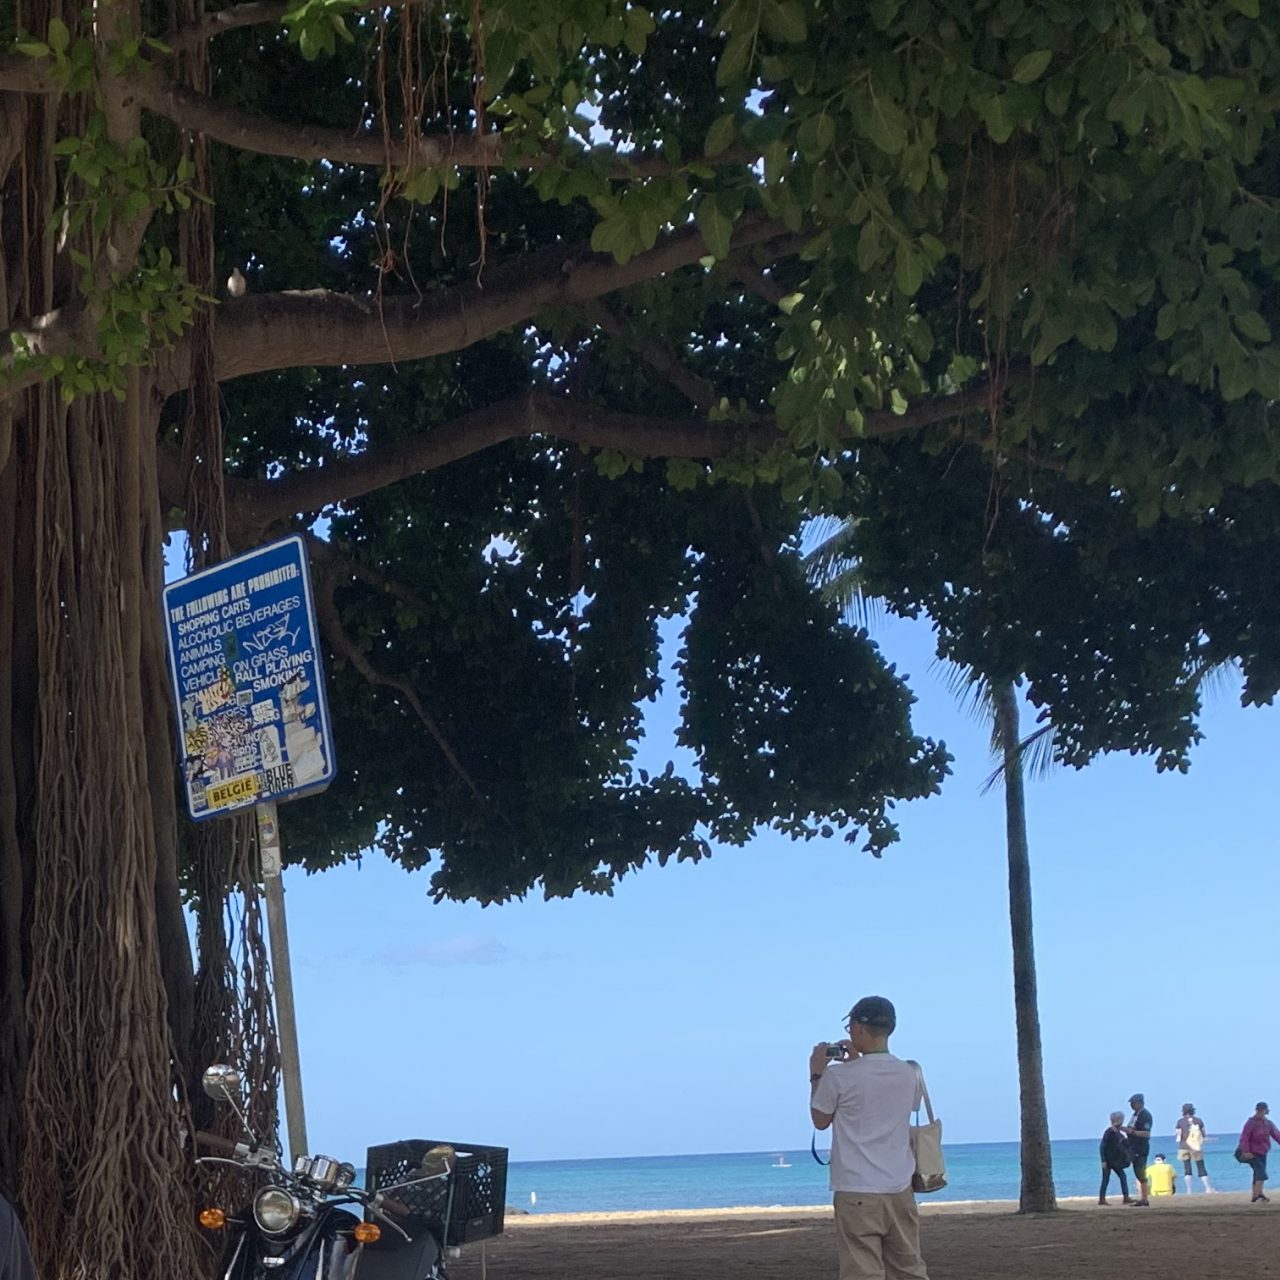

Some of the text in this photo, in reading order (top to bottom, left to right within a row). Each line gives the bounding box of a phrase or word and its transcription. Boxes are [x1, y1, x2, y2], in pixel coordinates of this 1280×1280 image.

[170, 605, 185, 623] THE
[186, 588, 229, 618] FOLLOWING
[231, 581, 247, 601] ARE
[178, 610, 219, 636] SHOPPING
[221, 598, 251, 619] CARTS
[178, 620, 234, 650] ALCOHOLIC
[236, 595, 301, 629] BEVERAGES
[180, 639, 222, 665] ANIMALS
[181, 653, 226, 678] CAMPING
[233, 659, 249, 674] ON
[251, 645, 289, 668] GRASS
[235, 649, 313, 684] BALL PLAYING
[253, 666, 306, 693] SMOKING
[213, 780, 253, 802] BELGIE
